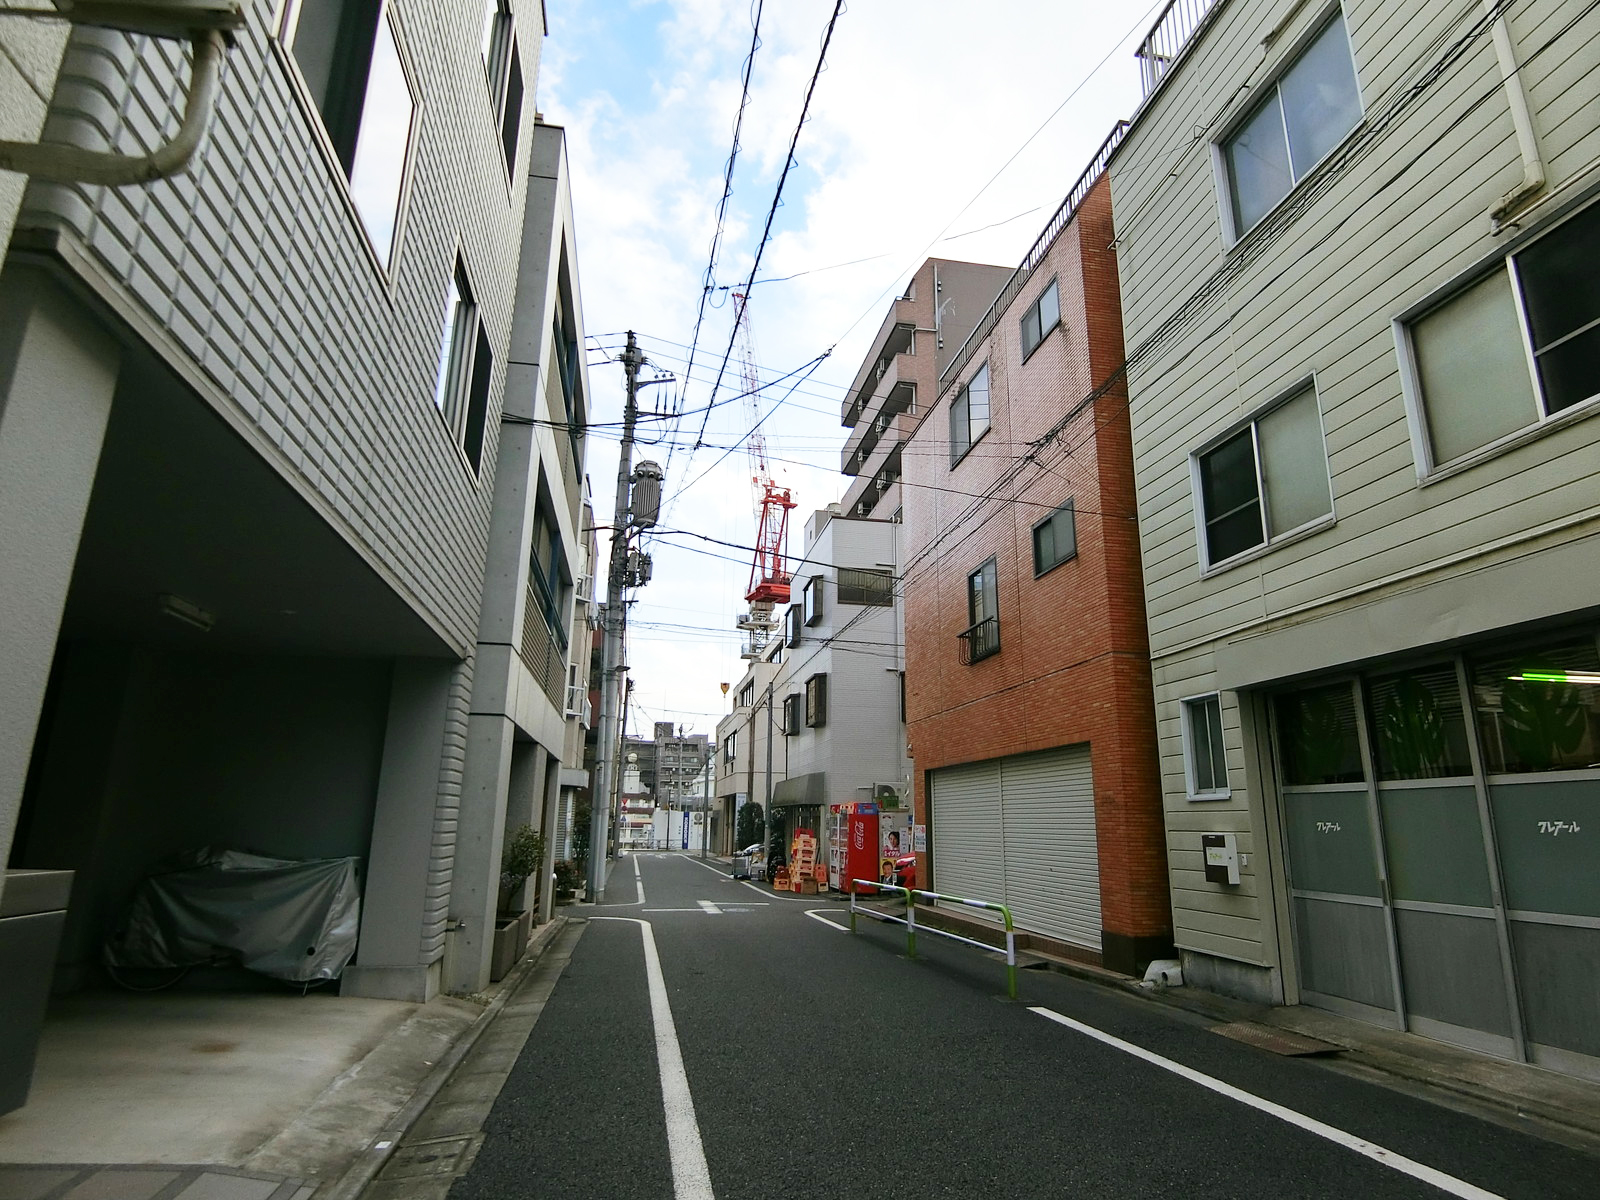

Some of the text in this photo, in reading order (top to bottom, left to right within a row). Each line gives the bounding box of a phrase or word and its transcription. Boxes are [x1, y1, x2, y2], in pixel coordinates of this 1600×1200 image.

[854, 820, 865, 850] Coca-Cola
[1537, 820, 1581, 836] クレアール
